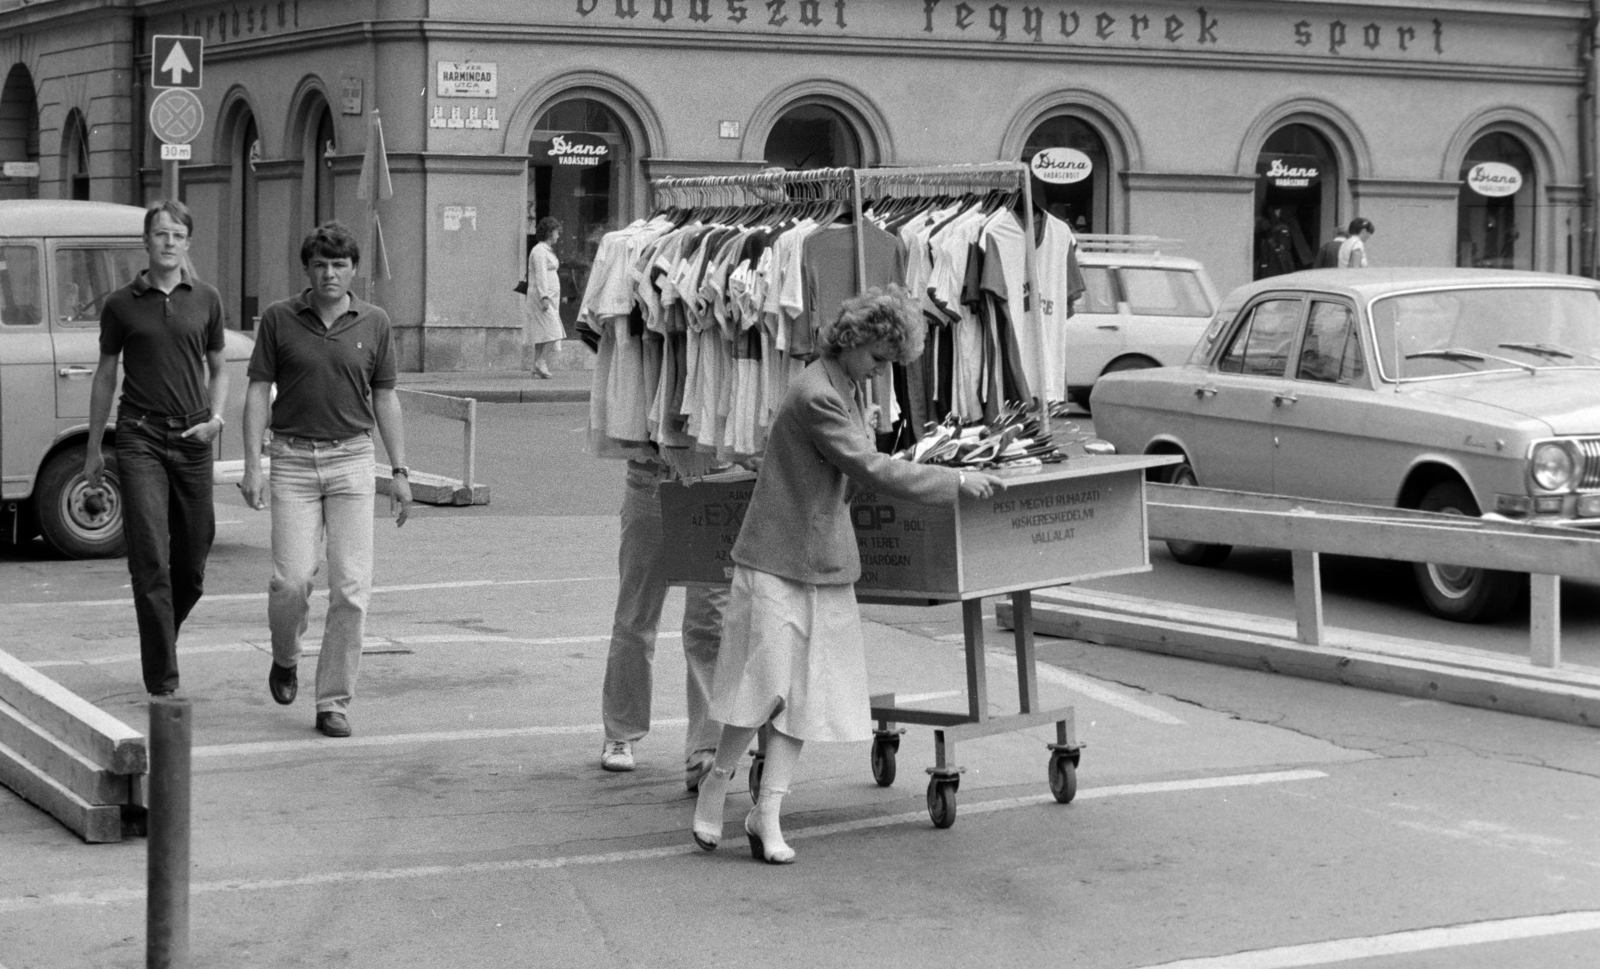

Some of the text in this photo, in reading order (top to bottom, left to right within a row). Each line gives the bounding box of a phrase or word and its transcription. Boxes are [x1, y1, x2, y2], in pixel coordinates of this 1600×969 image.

[922, 0, 1218, 44] fegyverek
[1294, 17, 1443, 56] sport
[443, 72, 491, 82] HARMINCAD
[548, 135, 608, 156] Diana
[558, 155, 599, 166] VADÁSZBOLT
[1034, 152, 1088, 170] Diana
[1266, 159, 1318, 177] Diana
[1471, 166, 1518, 184] Diana
[993, 500, 1016, 514] PEST
[1020, 496, 1054, 511] MEGYEI
[1011, 508, 1094, 529] KISKERESKEDELMI
